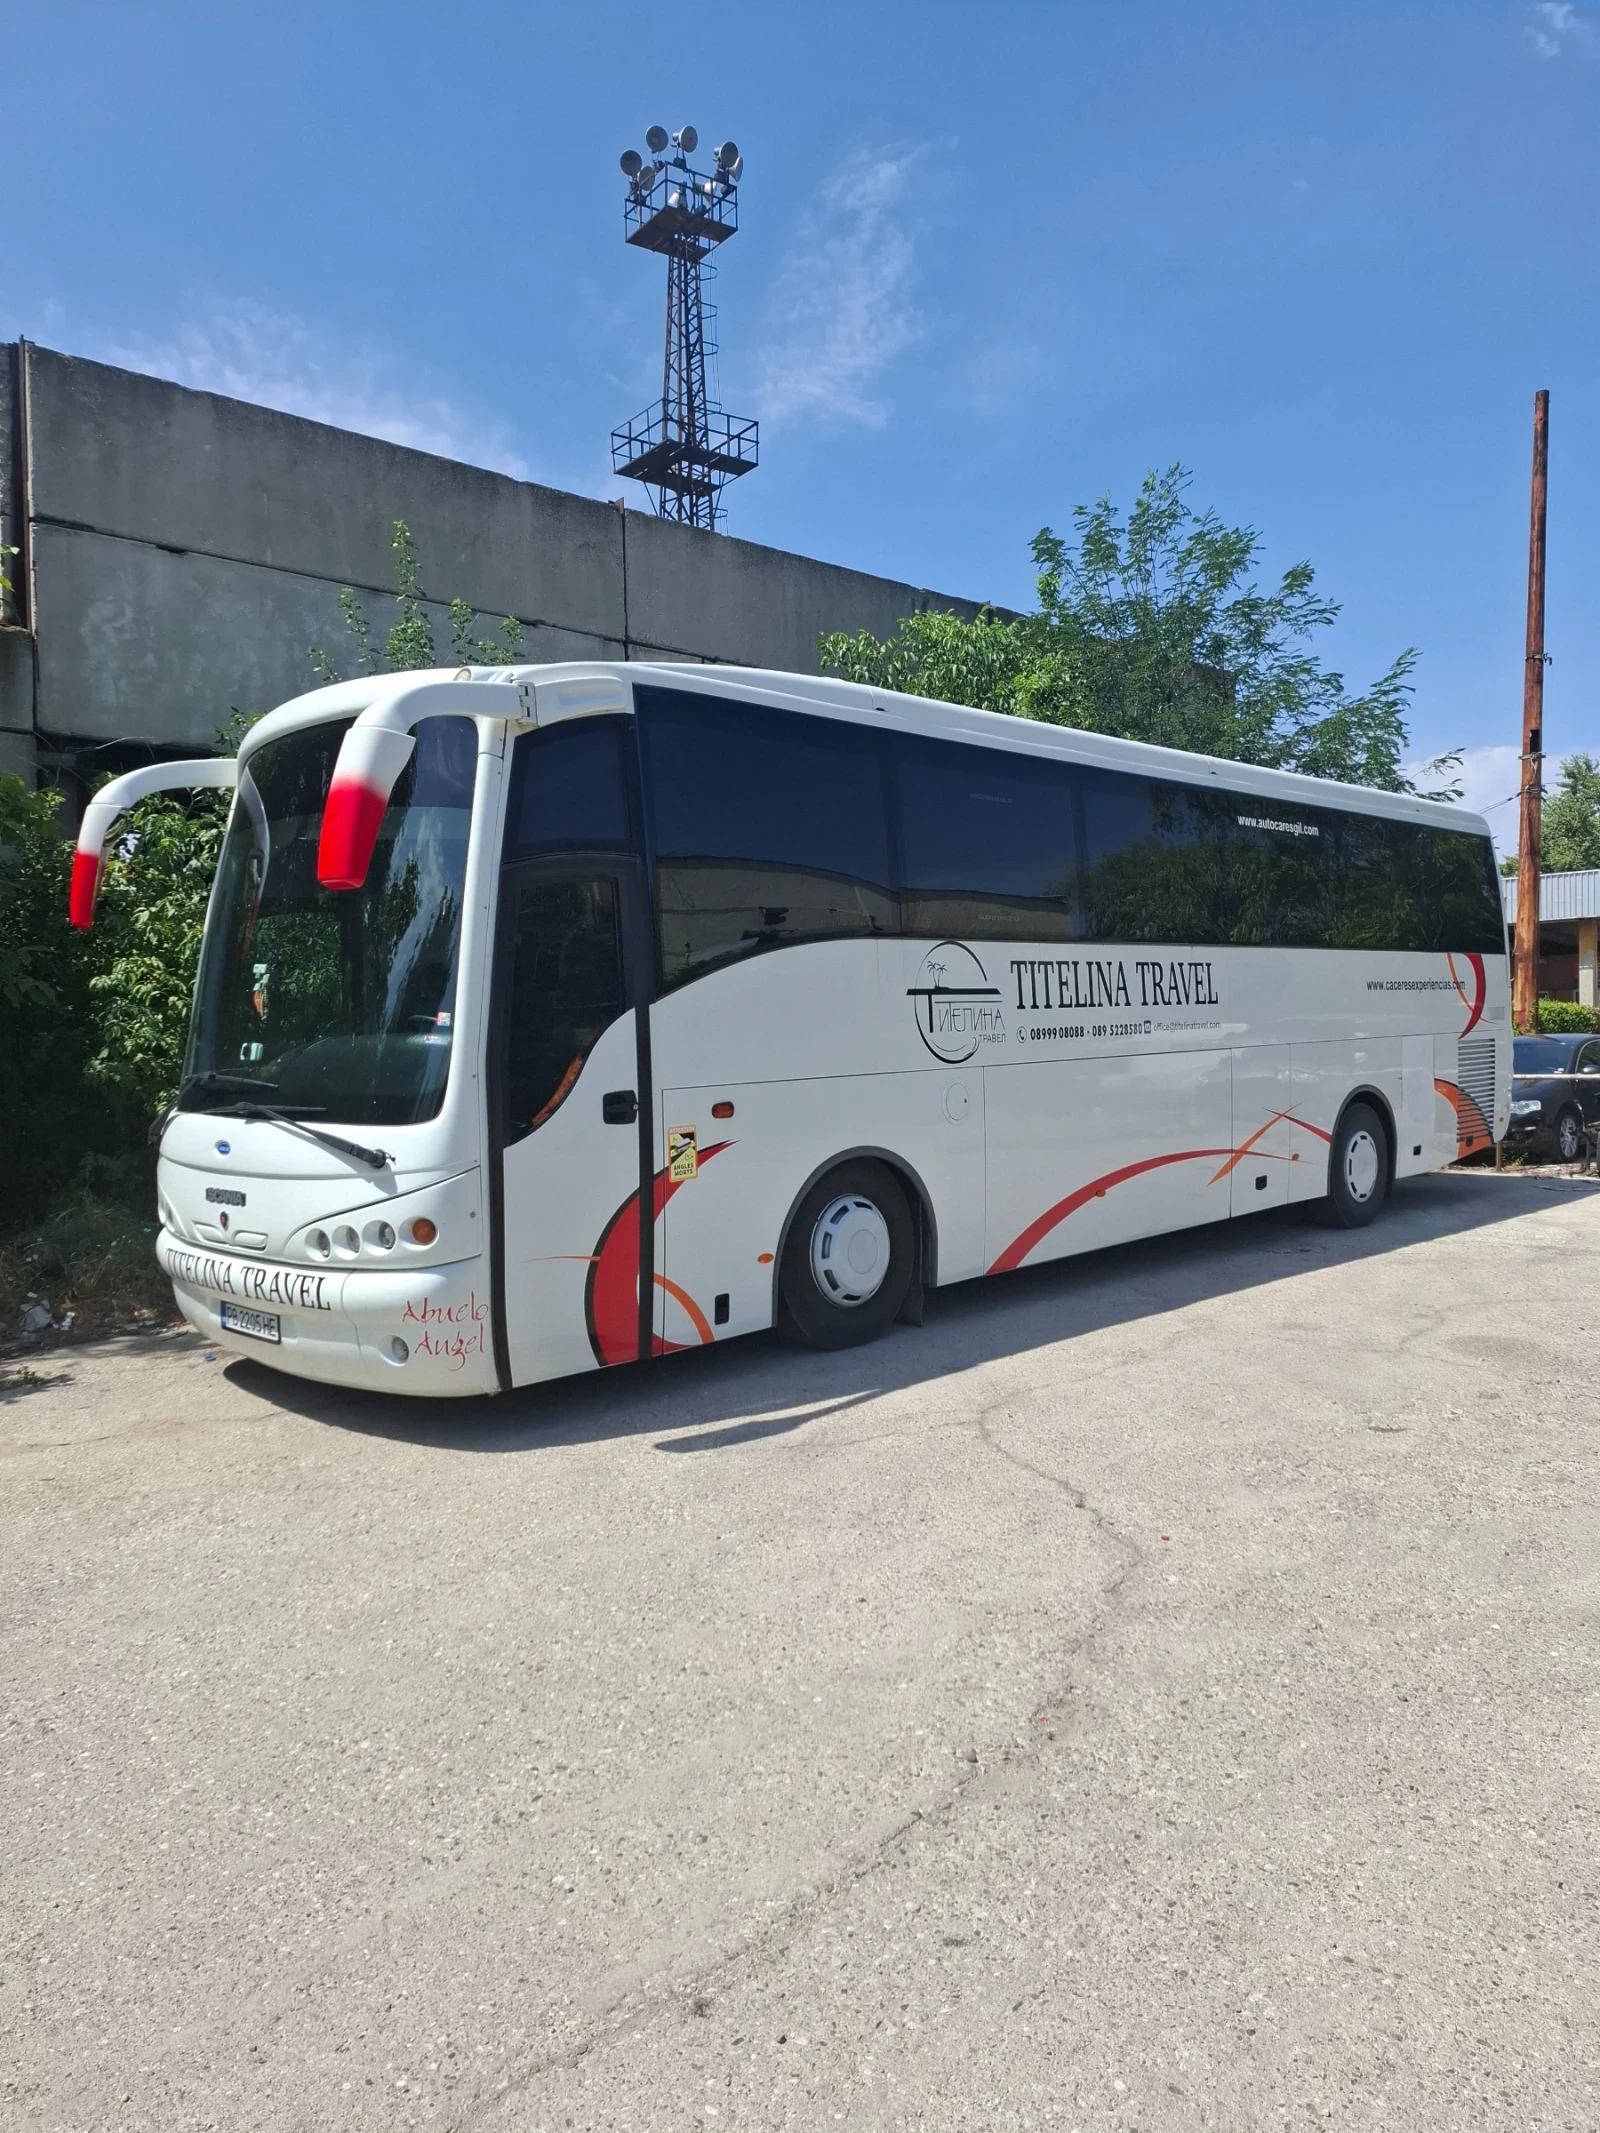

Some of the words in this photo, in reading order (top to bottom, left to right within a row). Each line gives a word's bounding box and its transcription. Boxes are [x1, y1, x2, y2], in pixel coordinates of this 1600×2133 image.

[1237, 815, 1319, 836] www.autocaresgil.com
[1010, 960, 1131, 1010] TITELINA
[1135, 961, 1218, 1006] TRAVEL
[1366, 977, 1466, 993] www.caceresexperiencias.com
[979, 1033, 1006, 1043] ТРАВЕЛ
[1092, 1024, 1107, 1037] 089
[1109, 1022, 1143, 1036] 5228580
[673, 1162, 694, 1171] ANGLES
[674, 1168, 693, 1177] MORTS
[206, 1187, 247, 1207] SCANIA
[166, 1248, 237, 1295] TITELINA
[240, 1266, 332, 1311] TRAVEL
[402, 1290, 489, 1328] Abuelo
[263, 1316, 277, 1338] HE
